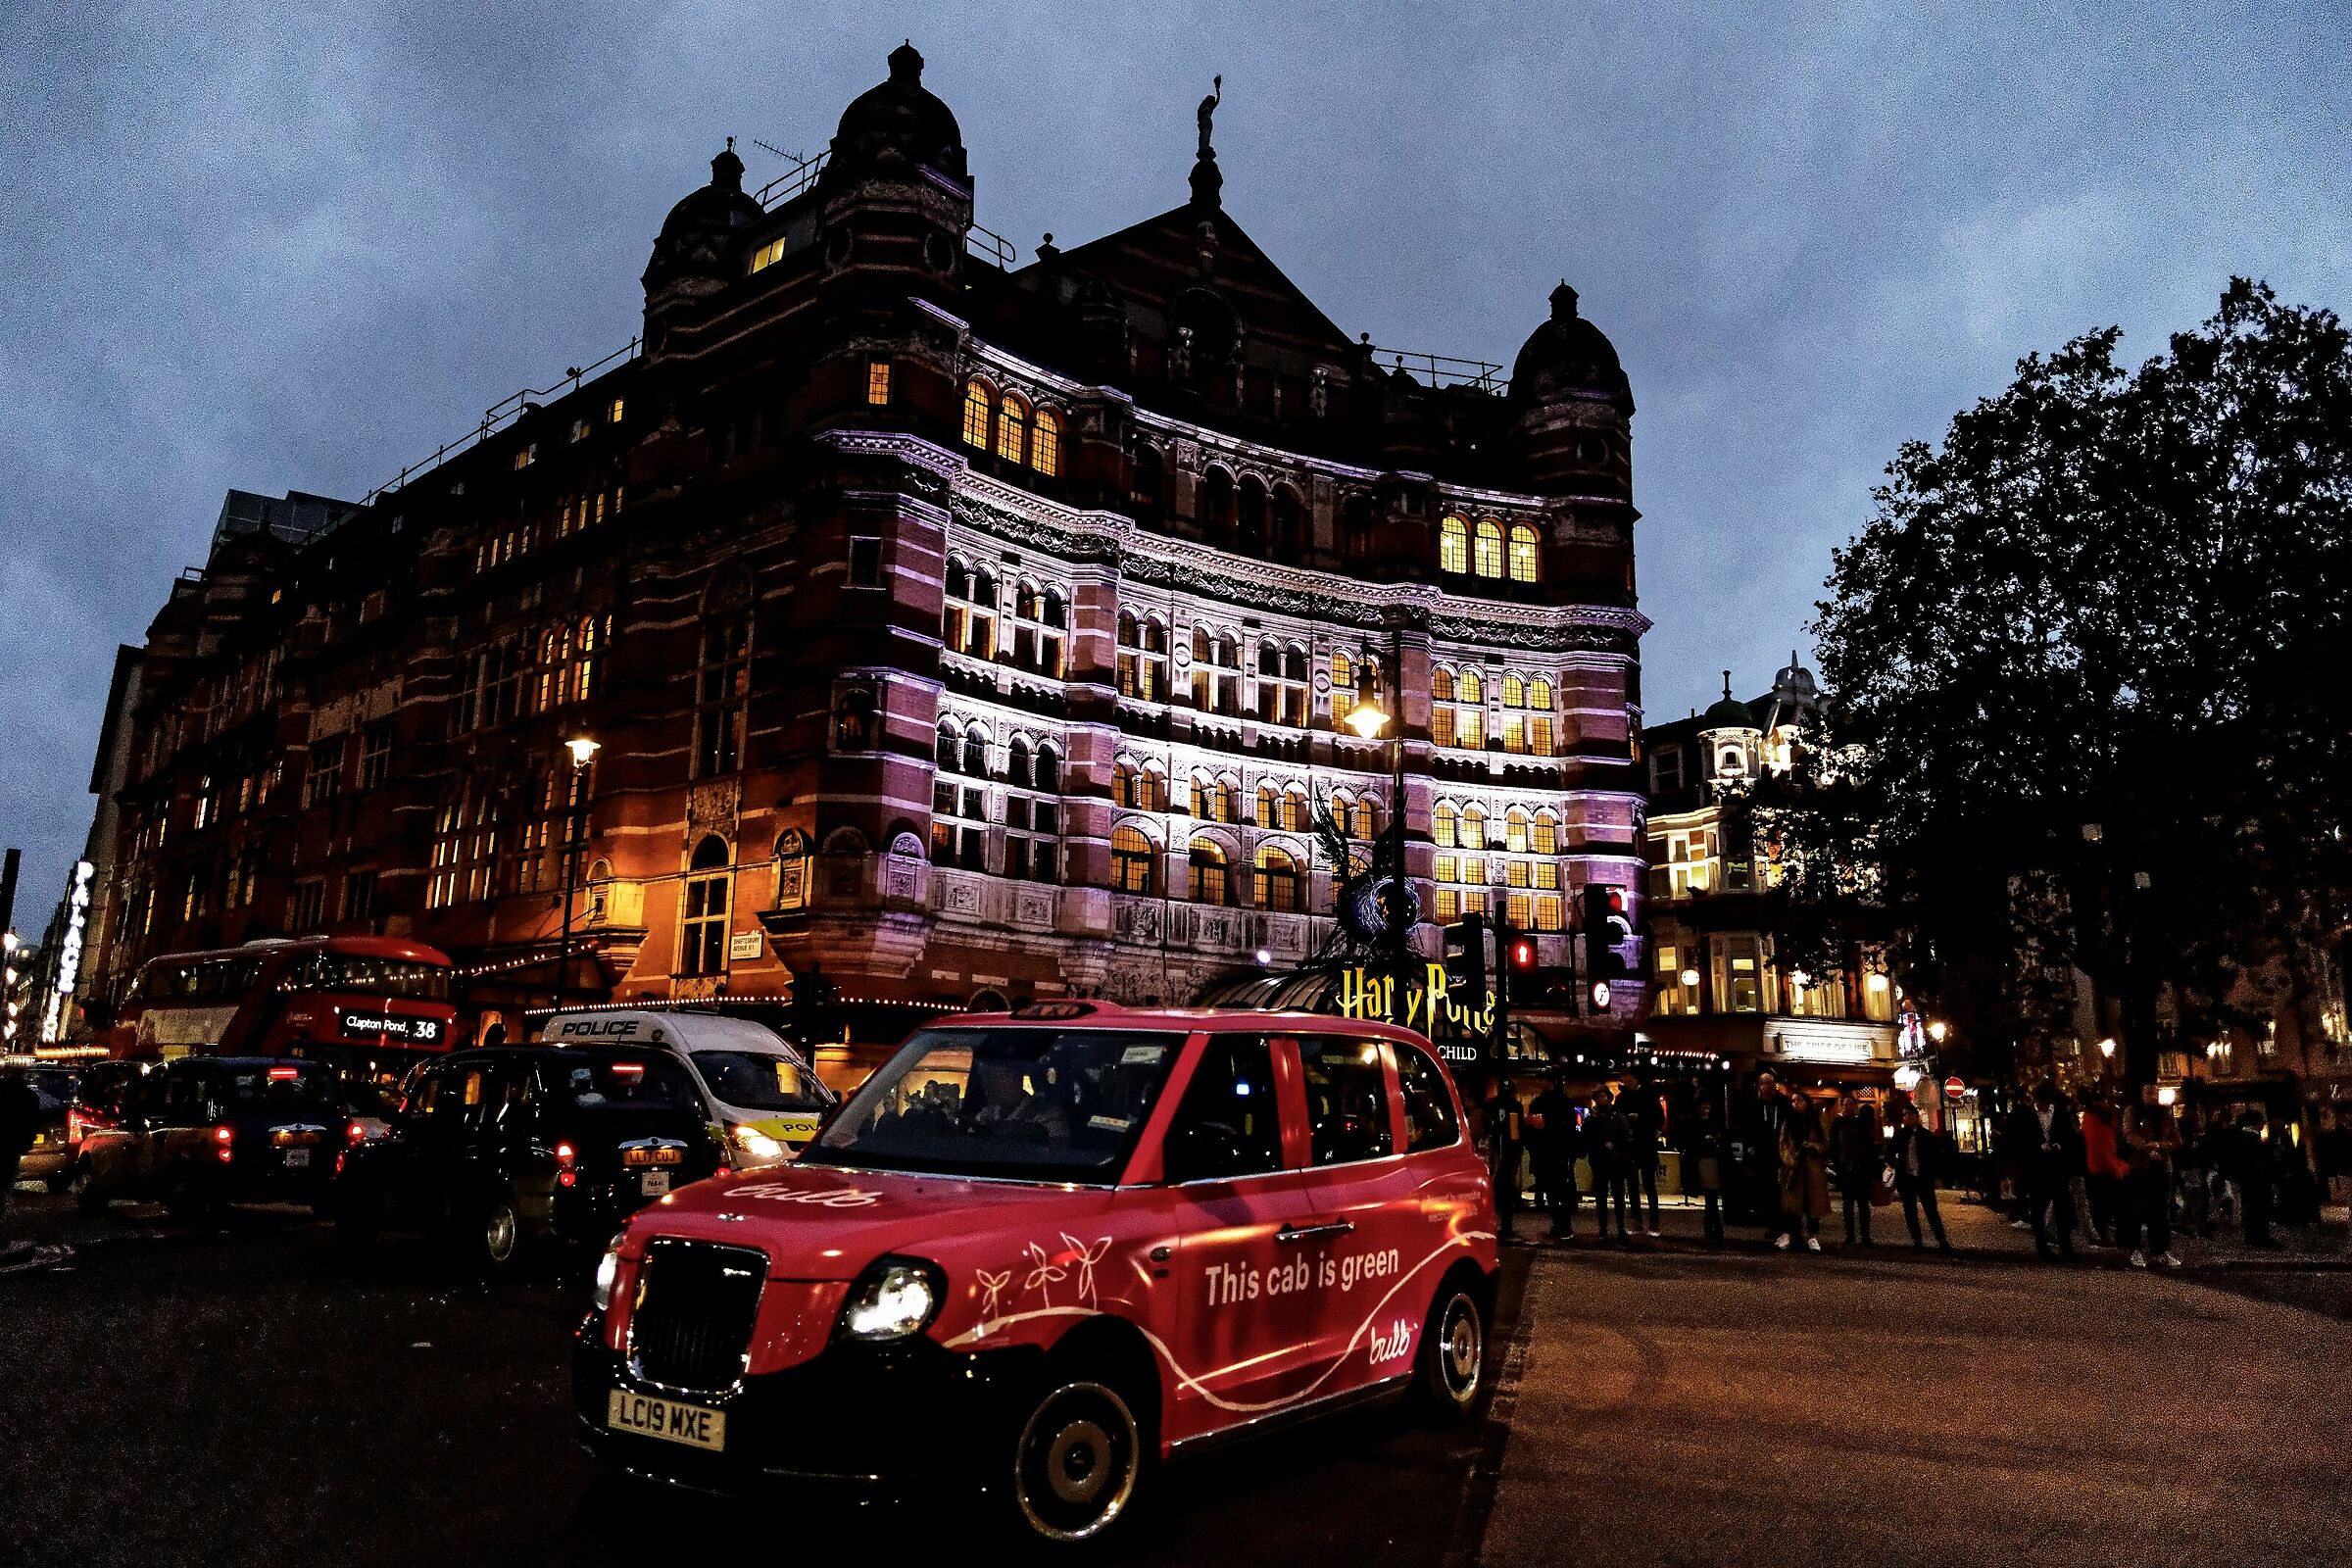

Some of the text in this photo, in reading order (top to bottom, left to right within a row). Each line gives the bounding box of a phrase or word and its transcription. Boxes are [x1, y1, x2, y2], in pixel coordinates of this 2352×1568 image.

[1335, 966, 1423, 1028] Hary
[1426, 963, 1496, 1041] Poe
[346, 1015, 436, 1039] Clapton Pond 38
[561, 1019, 640, 1037] POLICE
[1437, 1045, 1477, 1061] CHILD
[722, 1182, 884, 1208] bulb
[1204, 1248, 1399, 1306] This cab is green
[1369, 1318, 1411, 1365] bulb
[619, 1395, 712, 1443] LC19 MXE
